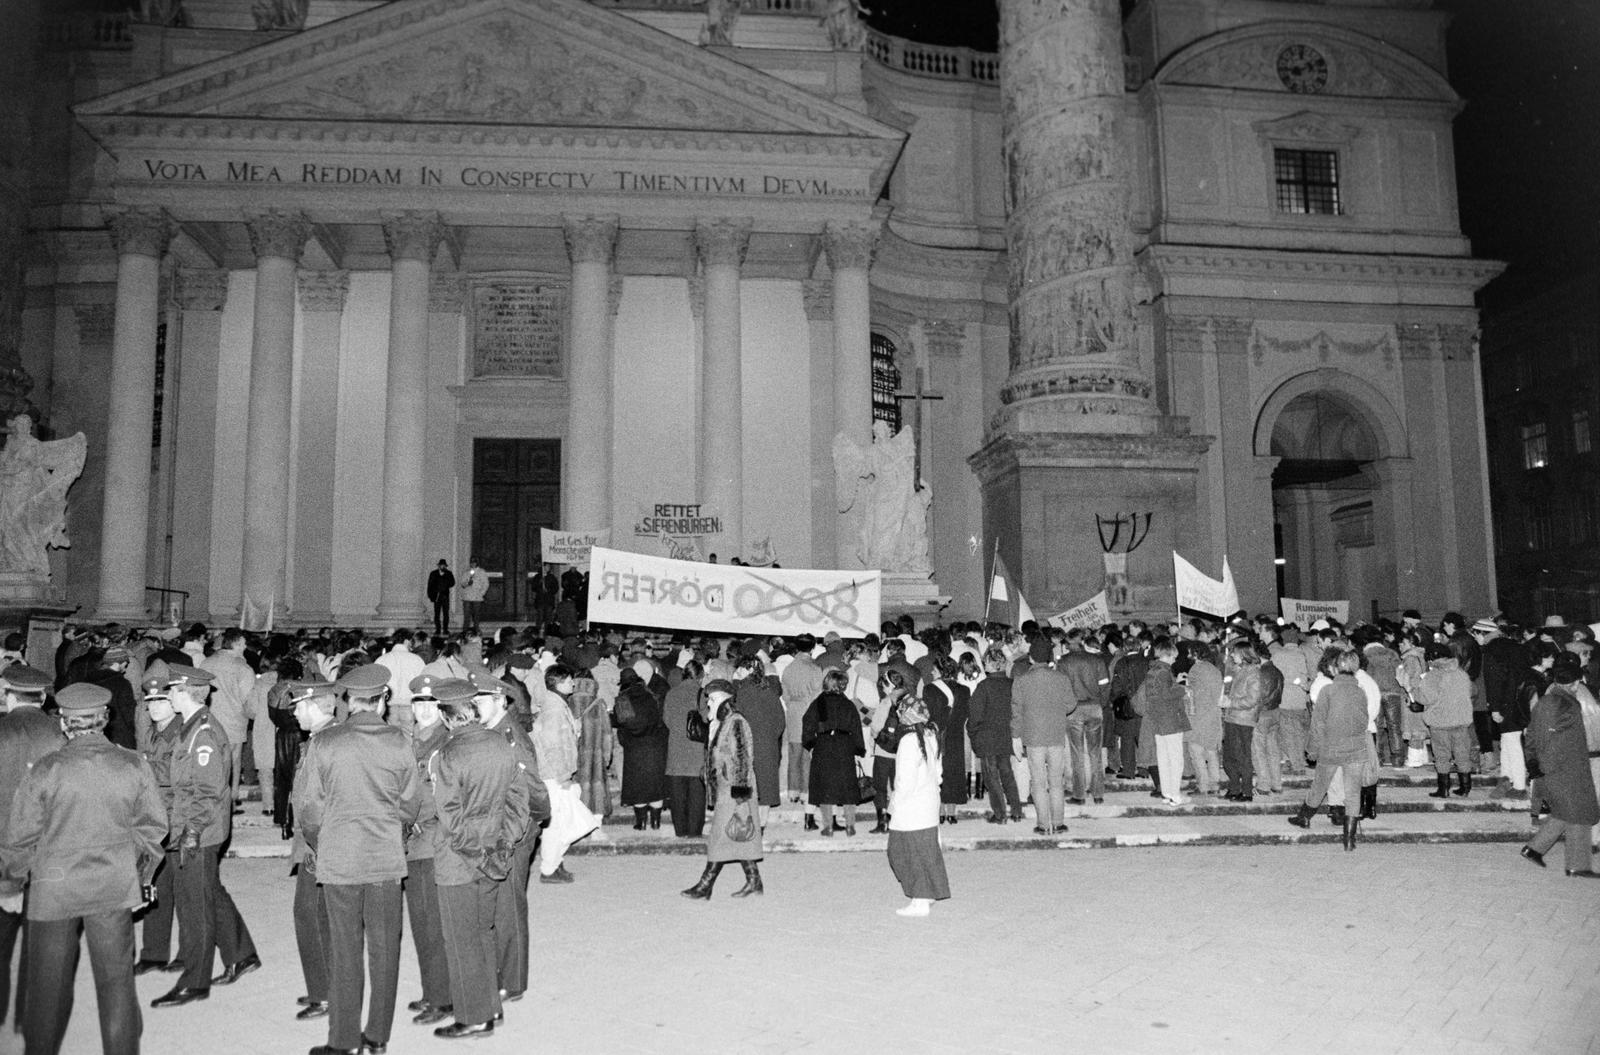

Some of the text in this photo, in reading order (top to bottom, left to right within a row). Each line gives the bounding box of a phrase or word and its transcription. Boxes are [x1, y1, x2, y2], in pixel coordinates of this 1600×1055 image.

[144, 159, 207, 180] VOTA
[227, 161, 282, 182] MEA
[302, 163, 401, 184] REDDAM
[421, 166, 442, 185] IN
[460, 167, 595, 188] CONSPECTV
[613, 171, 744, 193] TIMENTIVM
[763, 175, 828, 195] DEVM
[654, 504, 702, 518] RETTET
[1058, 602, 1098, 628] Freiheit
